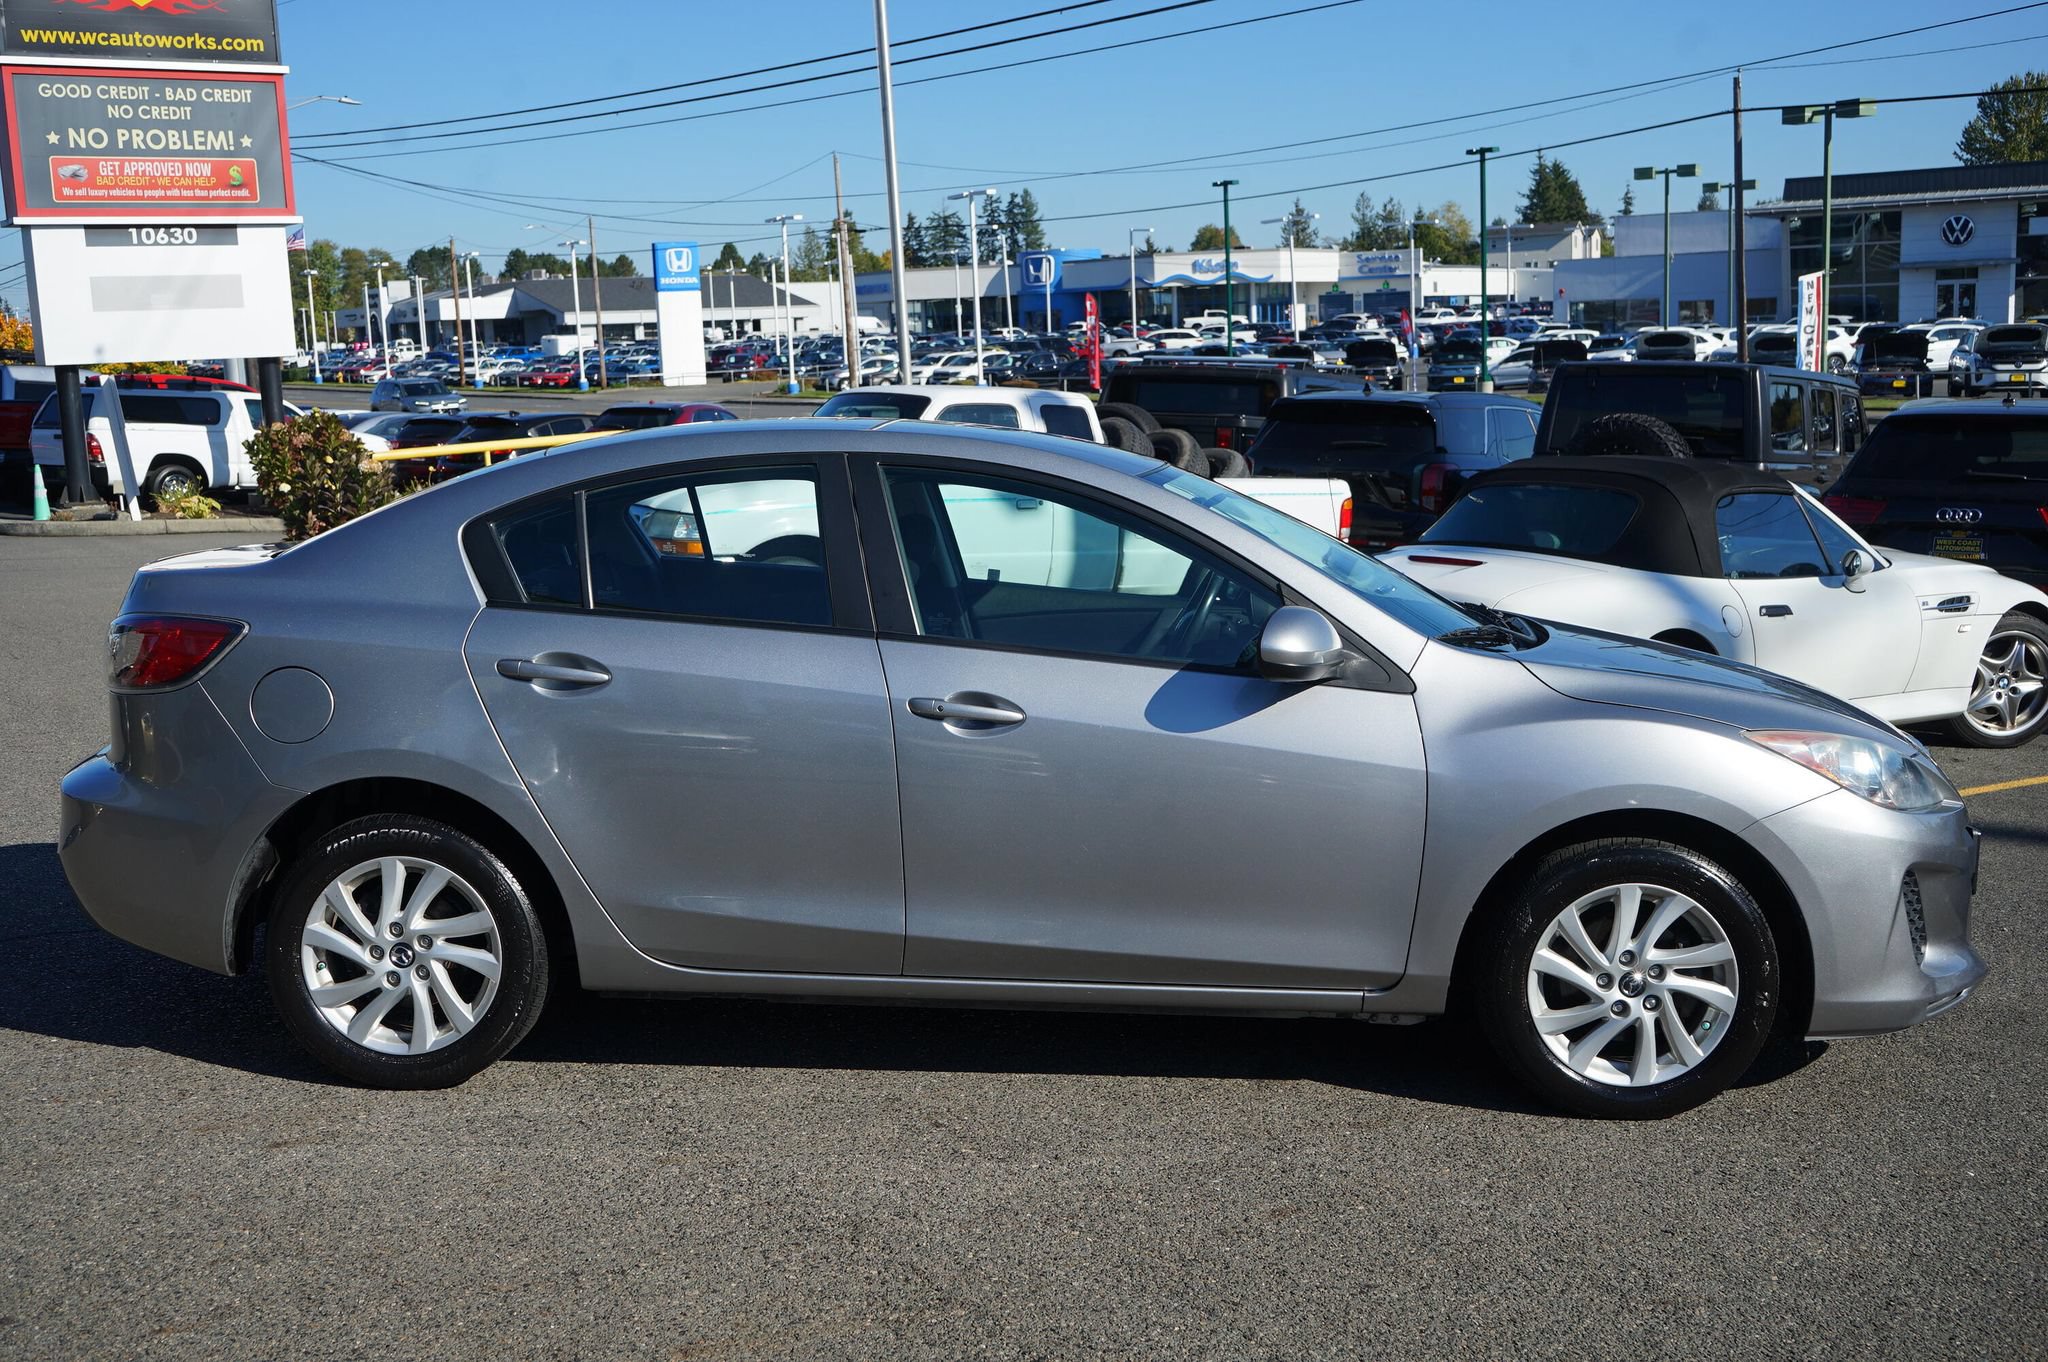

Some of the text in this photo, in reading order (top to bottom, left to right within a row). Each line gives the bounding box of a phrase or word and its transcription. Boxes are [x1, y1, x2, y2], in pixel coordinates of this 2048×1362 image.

[20, 28, 265, 52] www.wcautoworks.com
[38, 83, 92, 99] GOOD
[96, 84, 150, 100] CREDIT
[165, 86, 197, 102] BAD
[201, 87, 252, 103] CREDIT
[107, 104, 192, 120] NO CREDIT
[67, 127, 235, 151] NO PROBLEM!
[99, 161, 211, 177] GET APPROVED NOW
[96, 176, 217, 187] BAD CREDIT WE CAN HELP
[62, 187, 74, 196] We
[74, 187, 87, 196] sell
[88, 187, 108, 198] luxury
[108, 187, 136, 197] vehicles
[136, 187, 143, 197] to
[143, 187, 165, 199] people
[165, 187, 181, 197] with
[181, 187, 194, 197] less
[194, 187, 209, 197] than
[209, 187, 231, 199] perfect
[128, 227, 198, 245] 10630
[660, 276, 699, 285] HONDA
